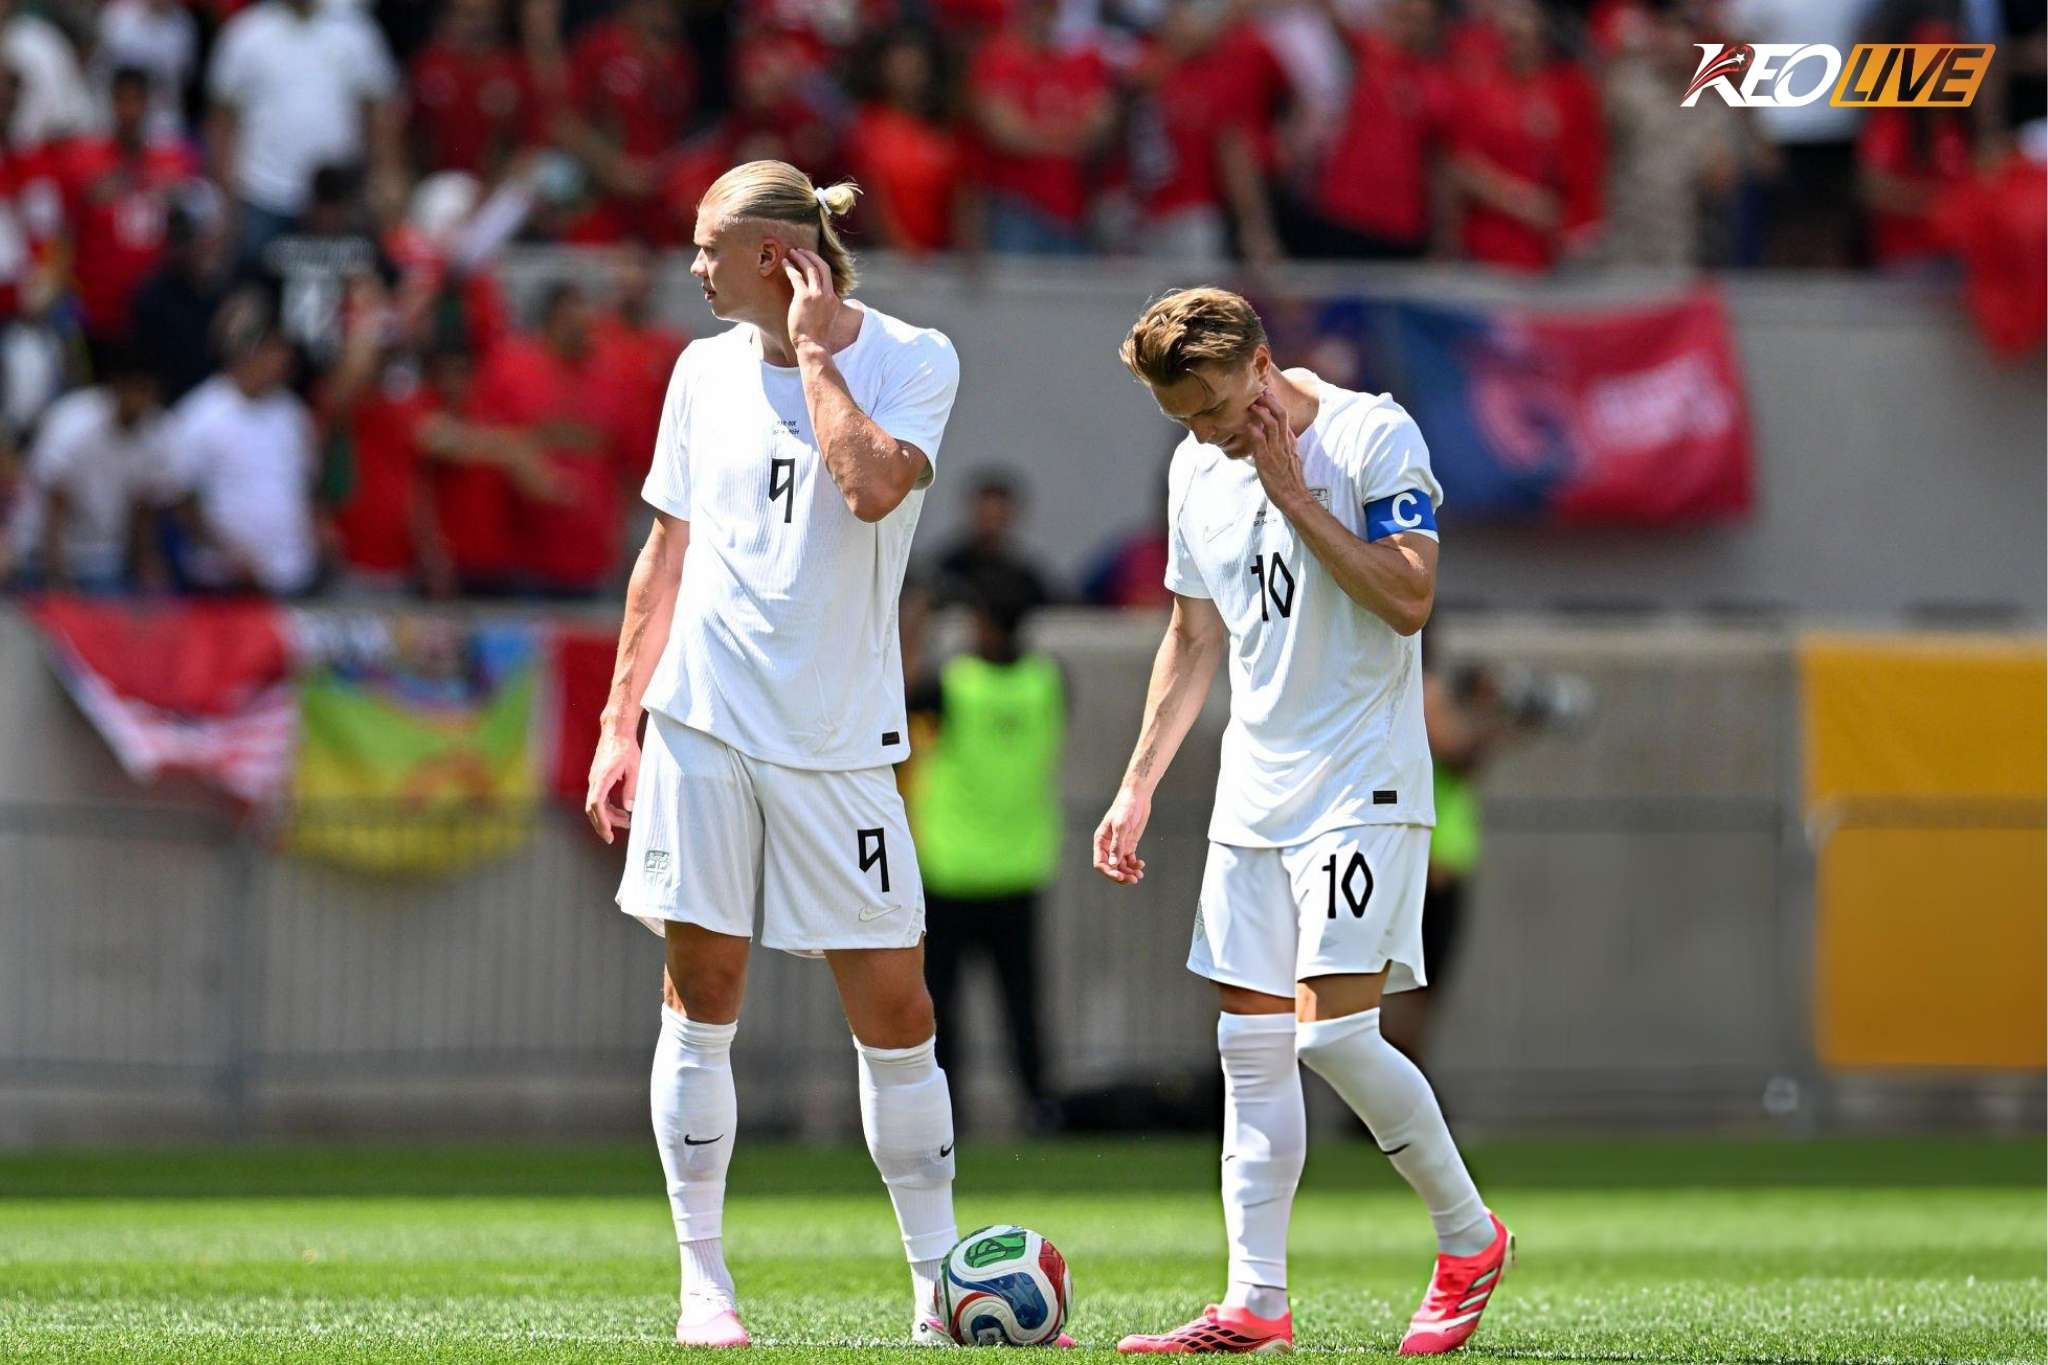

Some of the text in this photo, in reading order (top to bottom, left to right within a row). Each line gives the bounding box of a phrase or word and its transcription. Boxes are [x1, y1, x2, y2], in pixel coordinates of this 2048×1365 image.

[768, 458, 796, 524] 9
[1391, 492, 1423, 528] C
[1250, 551, 1296, 622] 10
[856, 827, 890, 893] 9
[1321, 852, 1375, 920] 10
